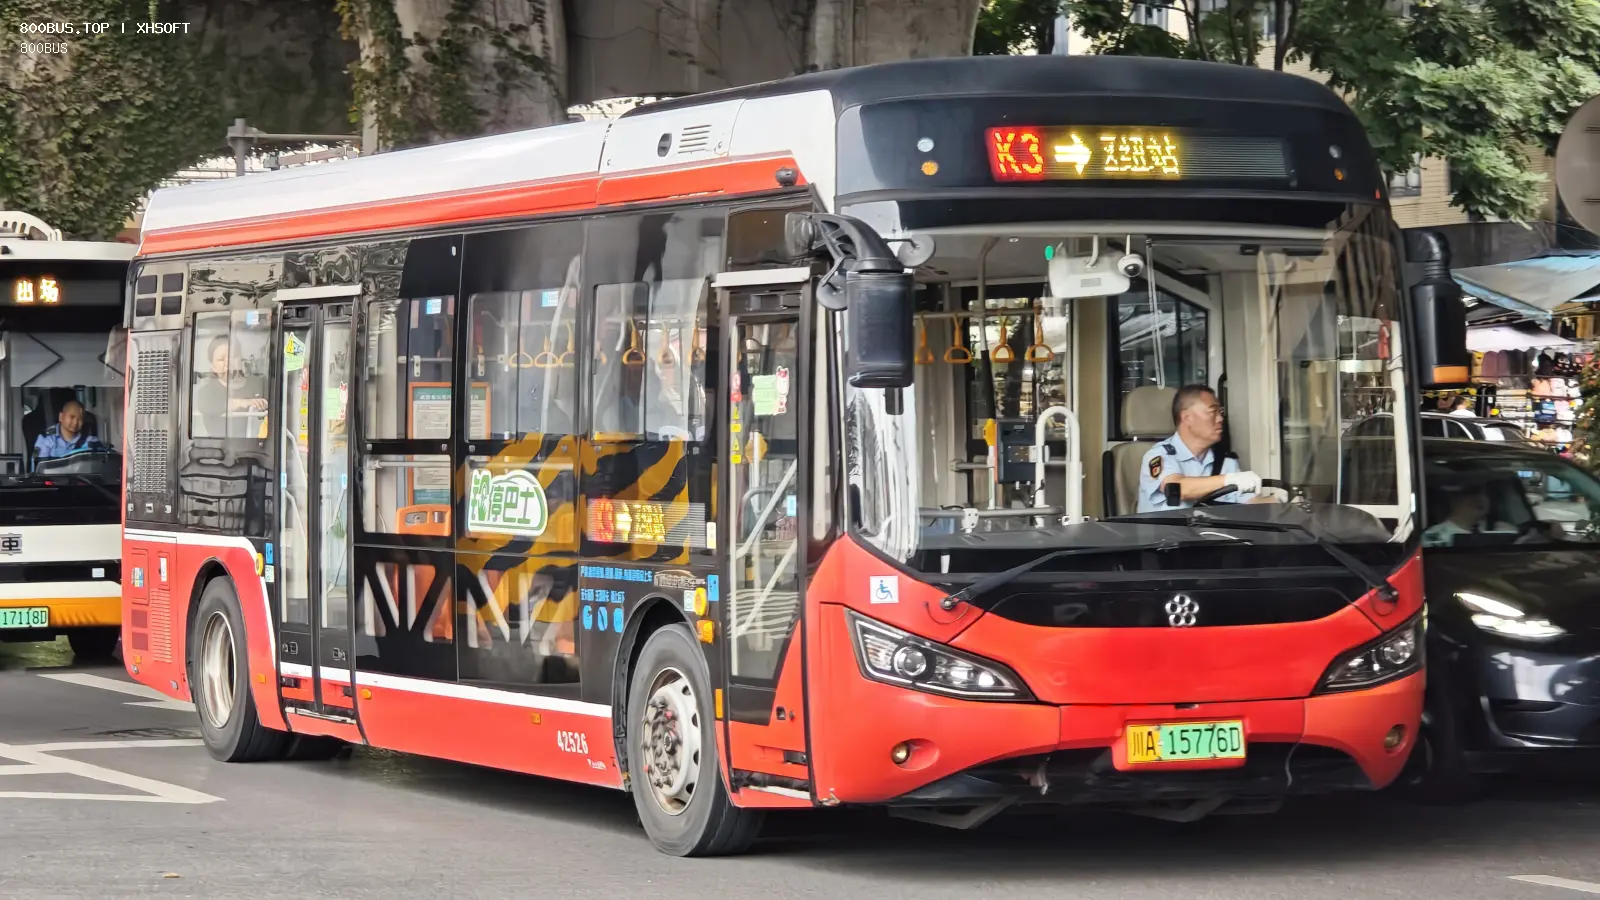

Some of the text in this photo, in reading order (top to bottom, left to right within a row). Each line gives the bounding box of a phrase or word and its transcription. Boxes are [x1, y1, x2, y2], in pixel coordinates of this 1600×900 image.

[994, 132, 1044, 174] K3
[16, 278, 59, 303] 出场
[2, 610, 48, 625] 17118D
[557, 729, 589, 755] 42526
[1133, 727, 1241, 757] 川A 15776D
